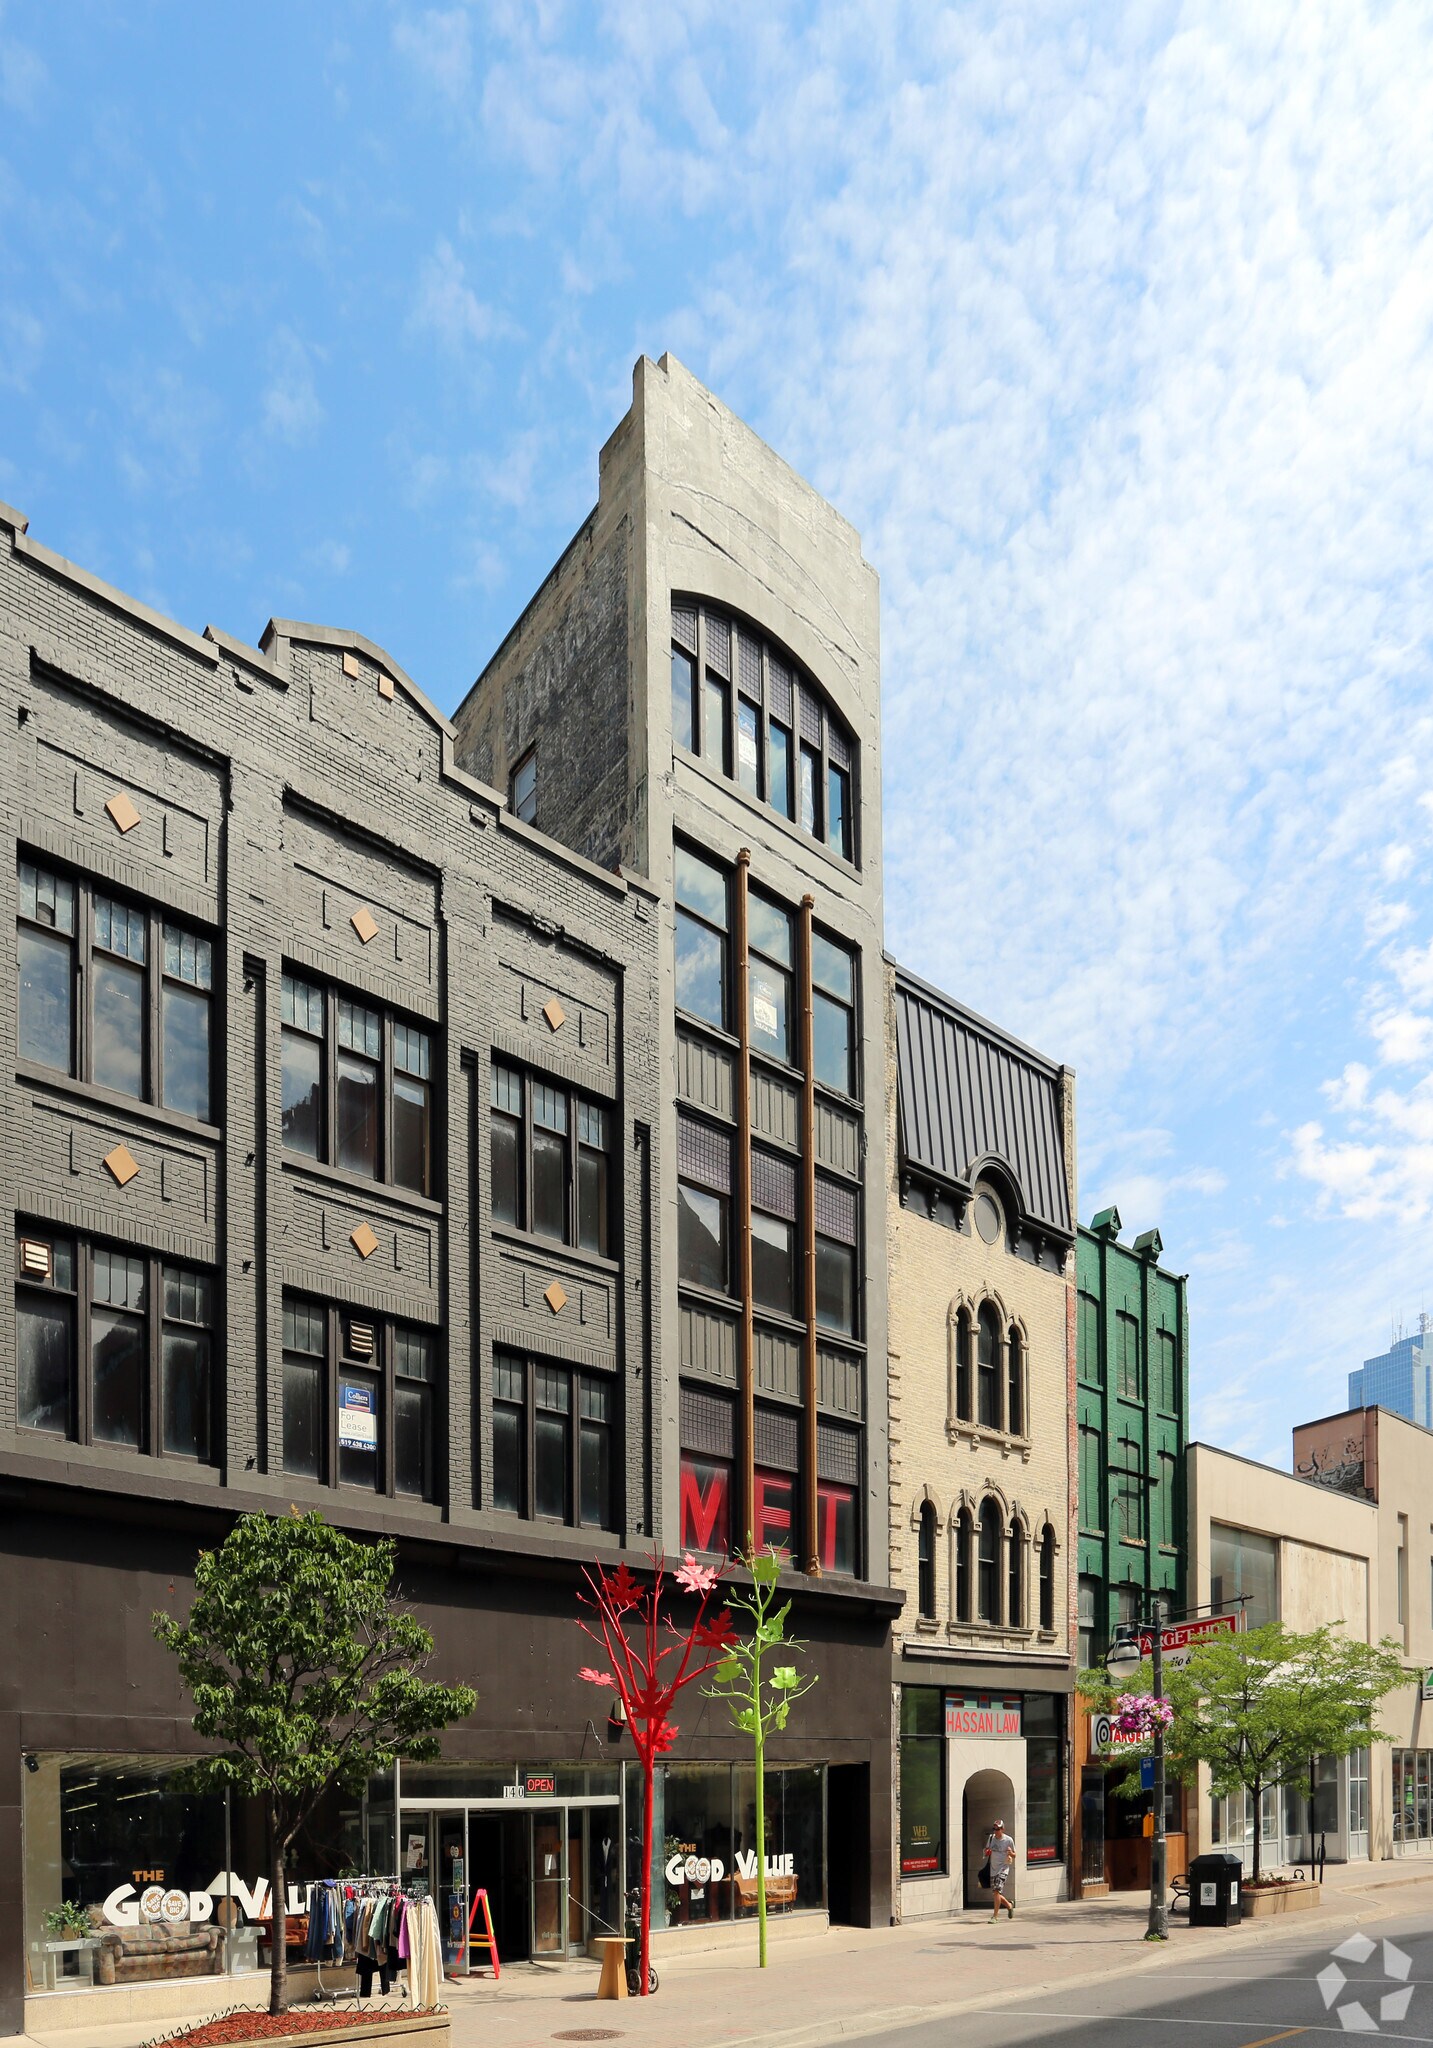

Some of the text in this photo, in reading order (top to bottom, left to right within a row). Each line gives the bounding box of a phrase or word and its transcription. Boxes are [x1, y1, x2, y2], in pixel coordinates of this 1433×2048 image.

[340, 1411, 356, 1421] For
[340, 1420, 367, 1432] Lease
[946, 1711, 1020, 1734] HASSAN LAW
[527, 1779, 554, 1791] OPEN
[504, 1786, 524, 1798] 140
[679, 1843, 697, 1853] THE
[665, 1853, 724, 1886] GOOD
[132, 1870, 164, 1882] THE
[102, 1883, 213, 1926] GOOD
